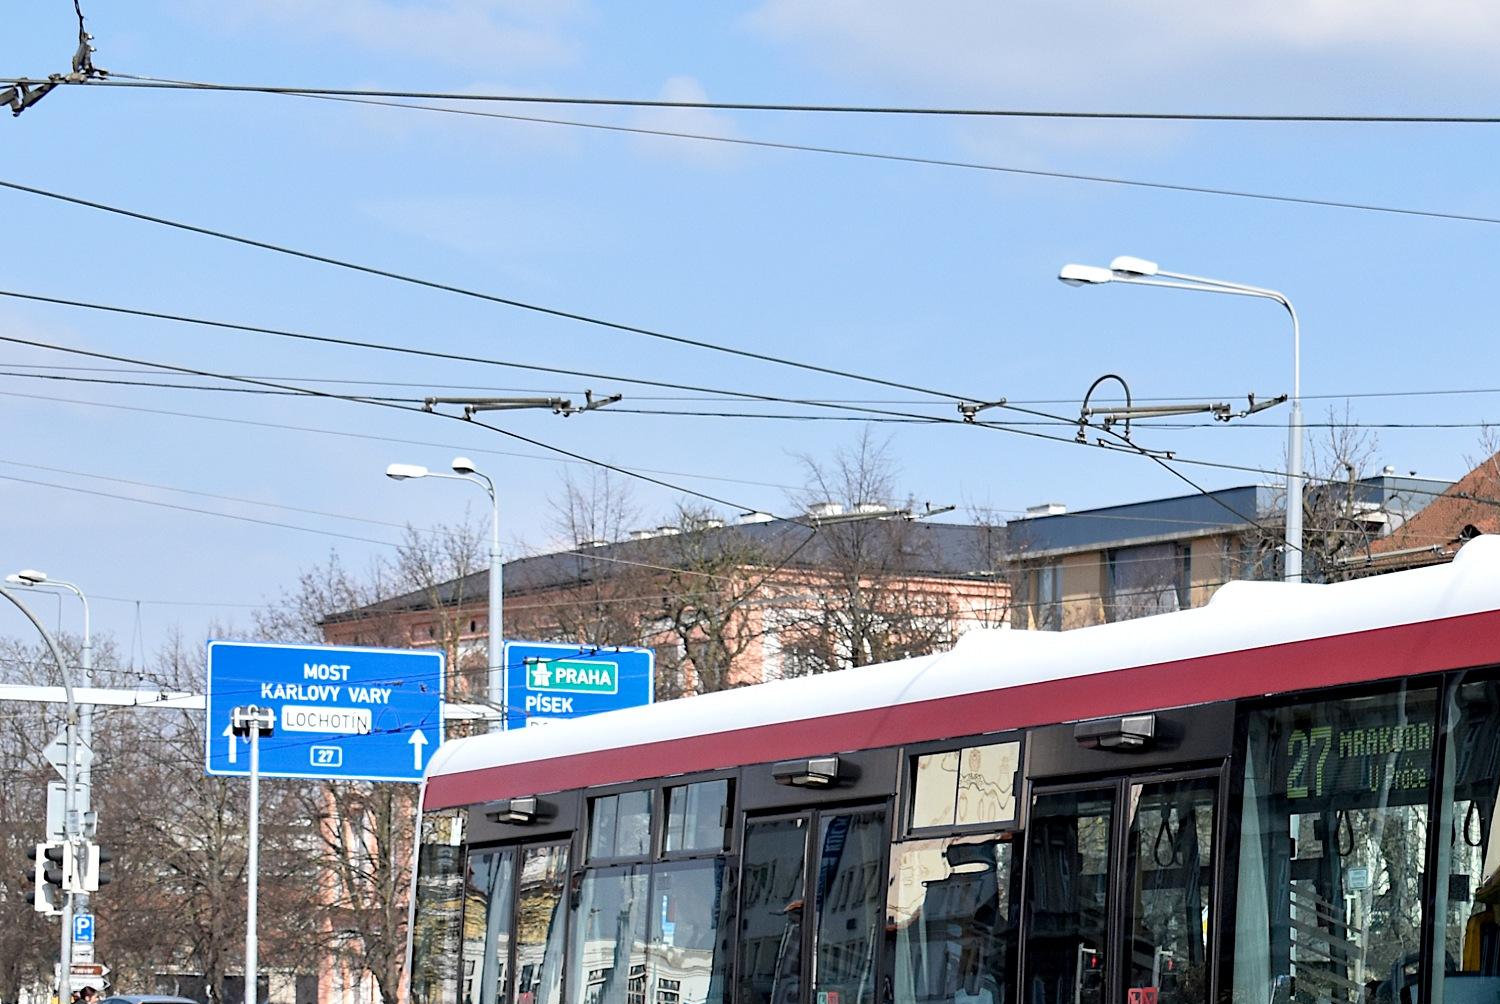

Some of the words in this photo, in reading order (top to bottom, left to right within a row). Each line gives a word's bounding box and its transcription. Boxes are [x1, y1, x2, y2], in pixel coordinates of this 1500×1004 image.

[303, 663, 351, 682] MOST
[555, 668, 612, 686] PRAHA
[261, 683, 341, 702] KARLOVY
[348, 687, 392, 704] VARY
[526, 693, 574, 713] PÍSEK
[286, 711, 368, 730] LOCHOTÍN
[318, 750, 334, 763] 27
[1287, 726, 1332, 798] 27
[1369, 764, 1379, 792] U
[77, 918, 90, 934] P
